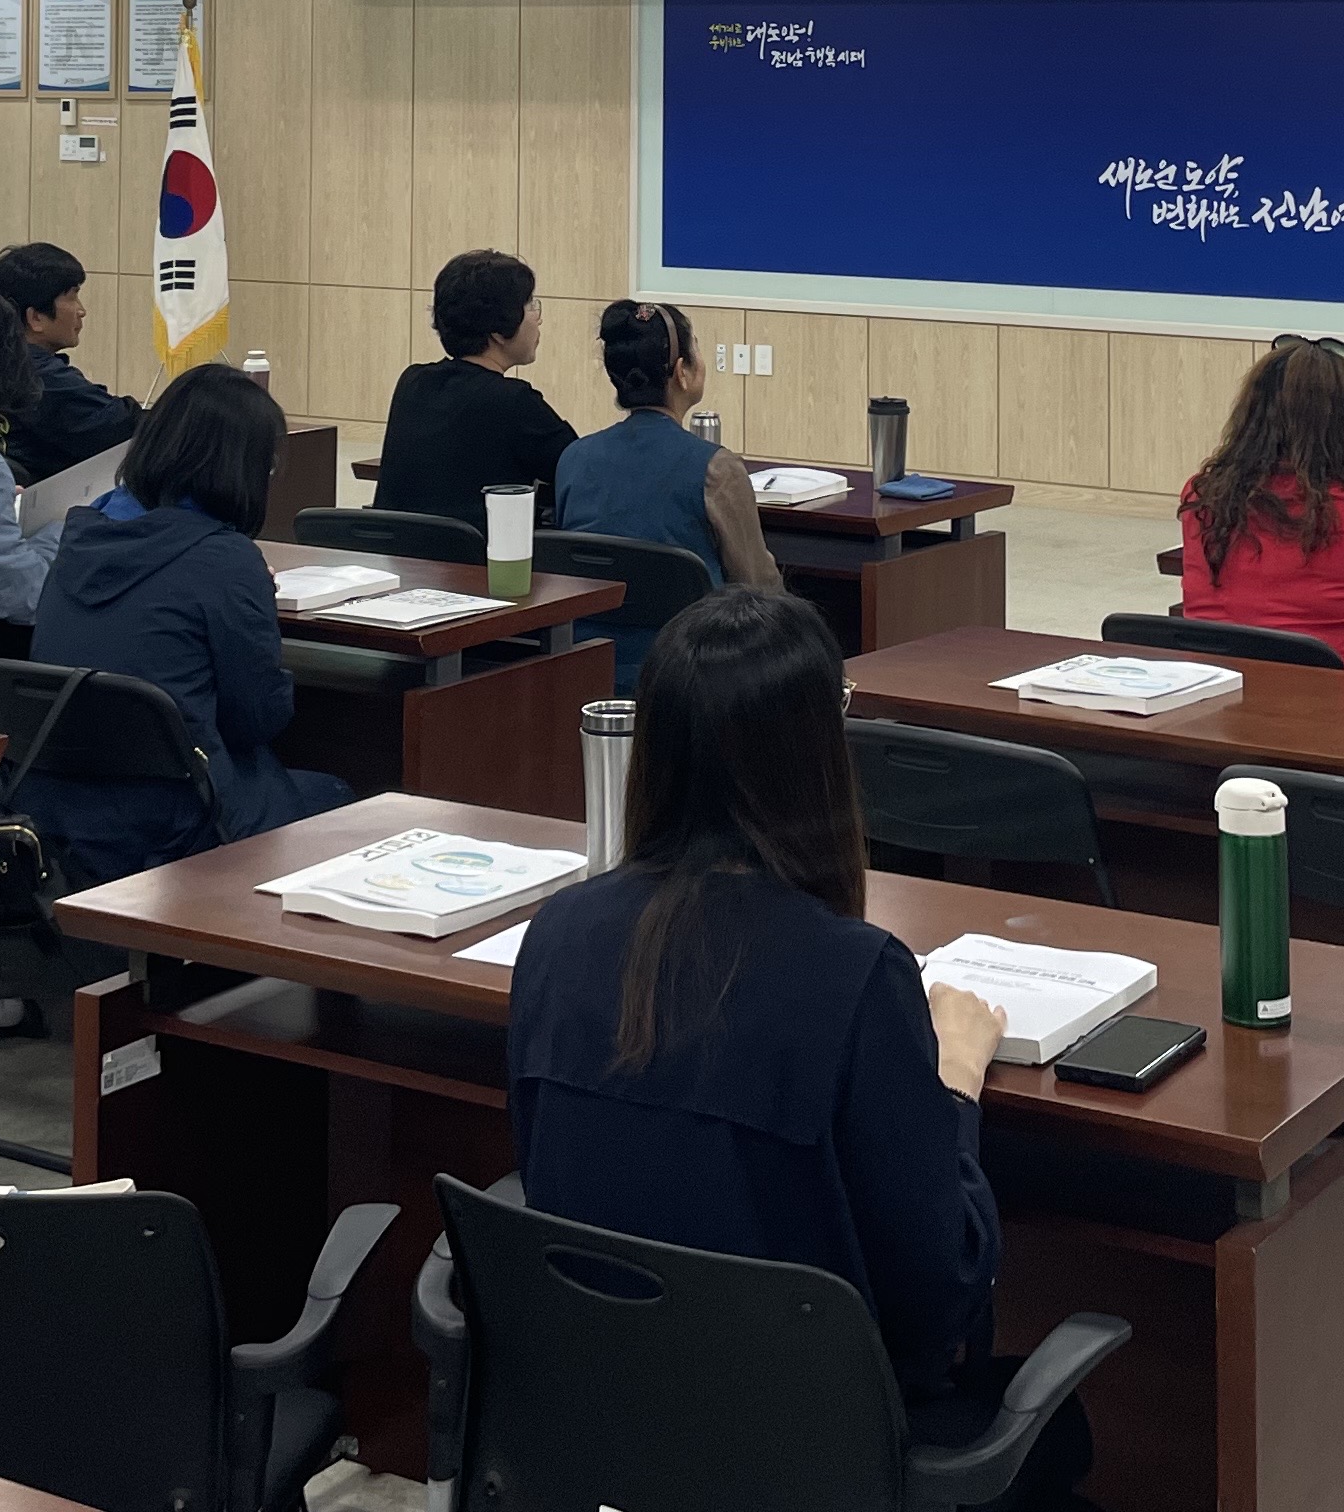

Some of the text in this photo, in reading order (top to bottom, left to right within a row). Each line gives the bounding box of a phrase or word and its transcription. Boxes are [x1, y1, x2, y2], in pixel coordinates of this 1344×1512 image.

[746, 20, 814, 60] 대도약!
[770, 49, 804, 69] 전남
[1098, 157, 1178, 220] 새로운
[1152, 193, 1250, 243] 변화하는
